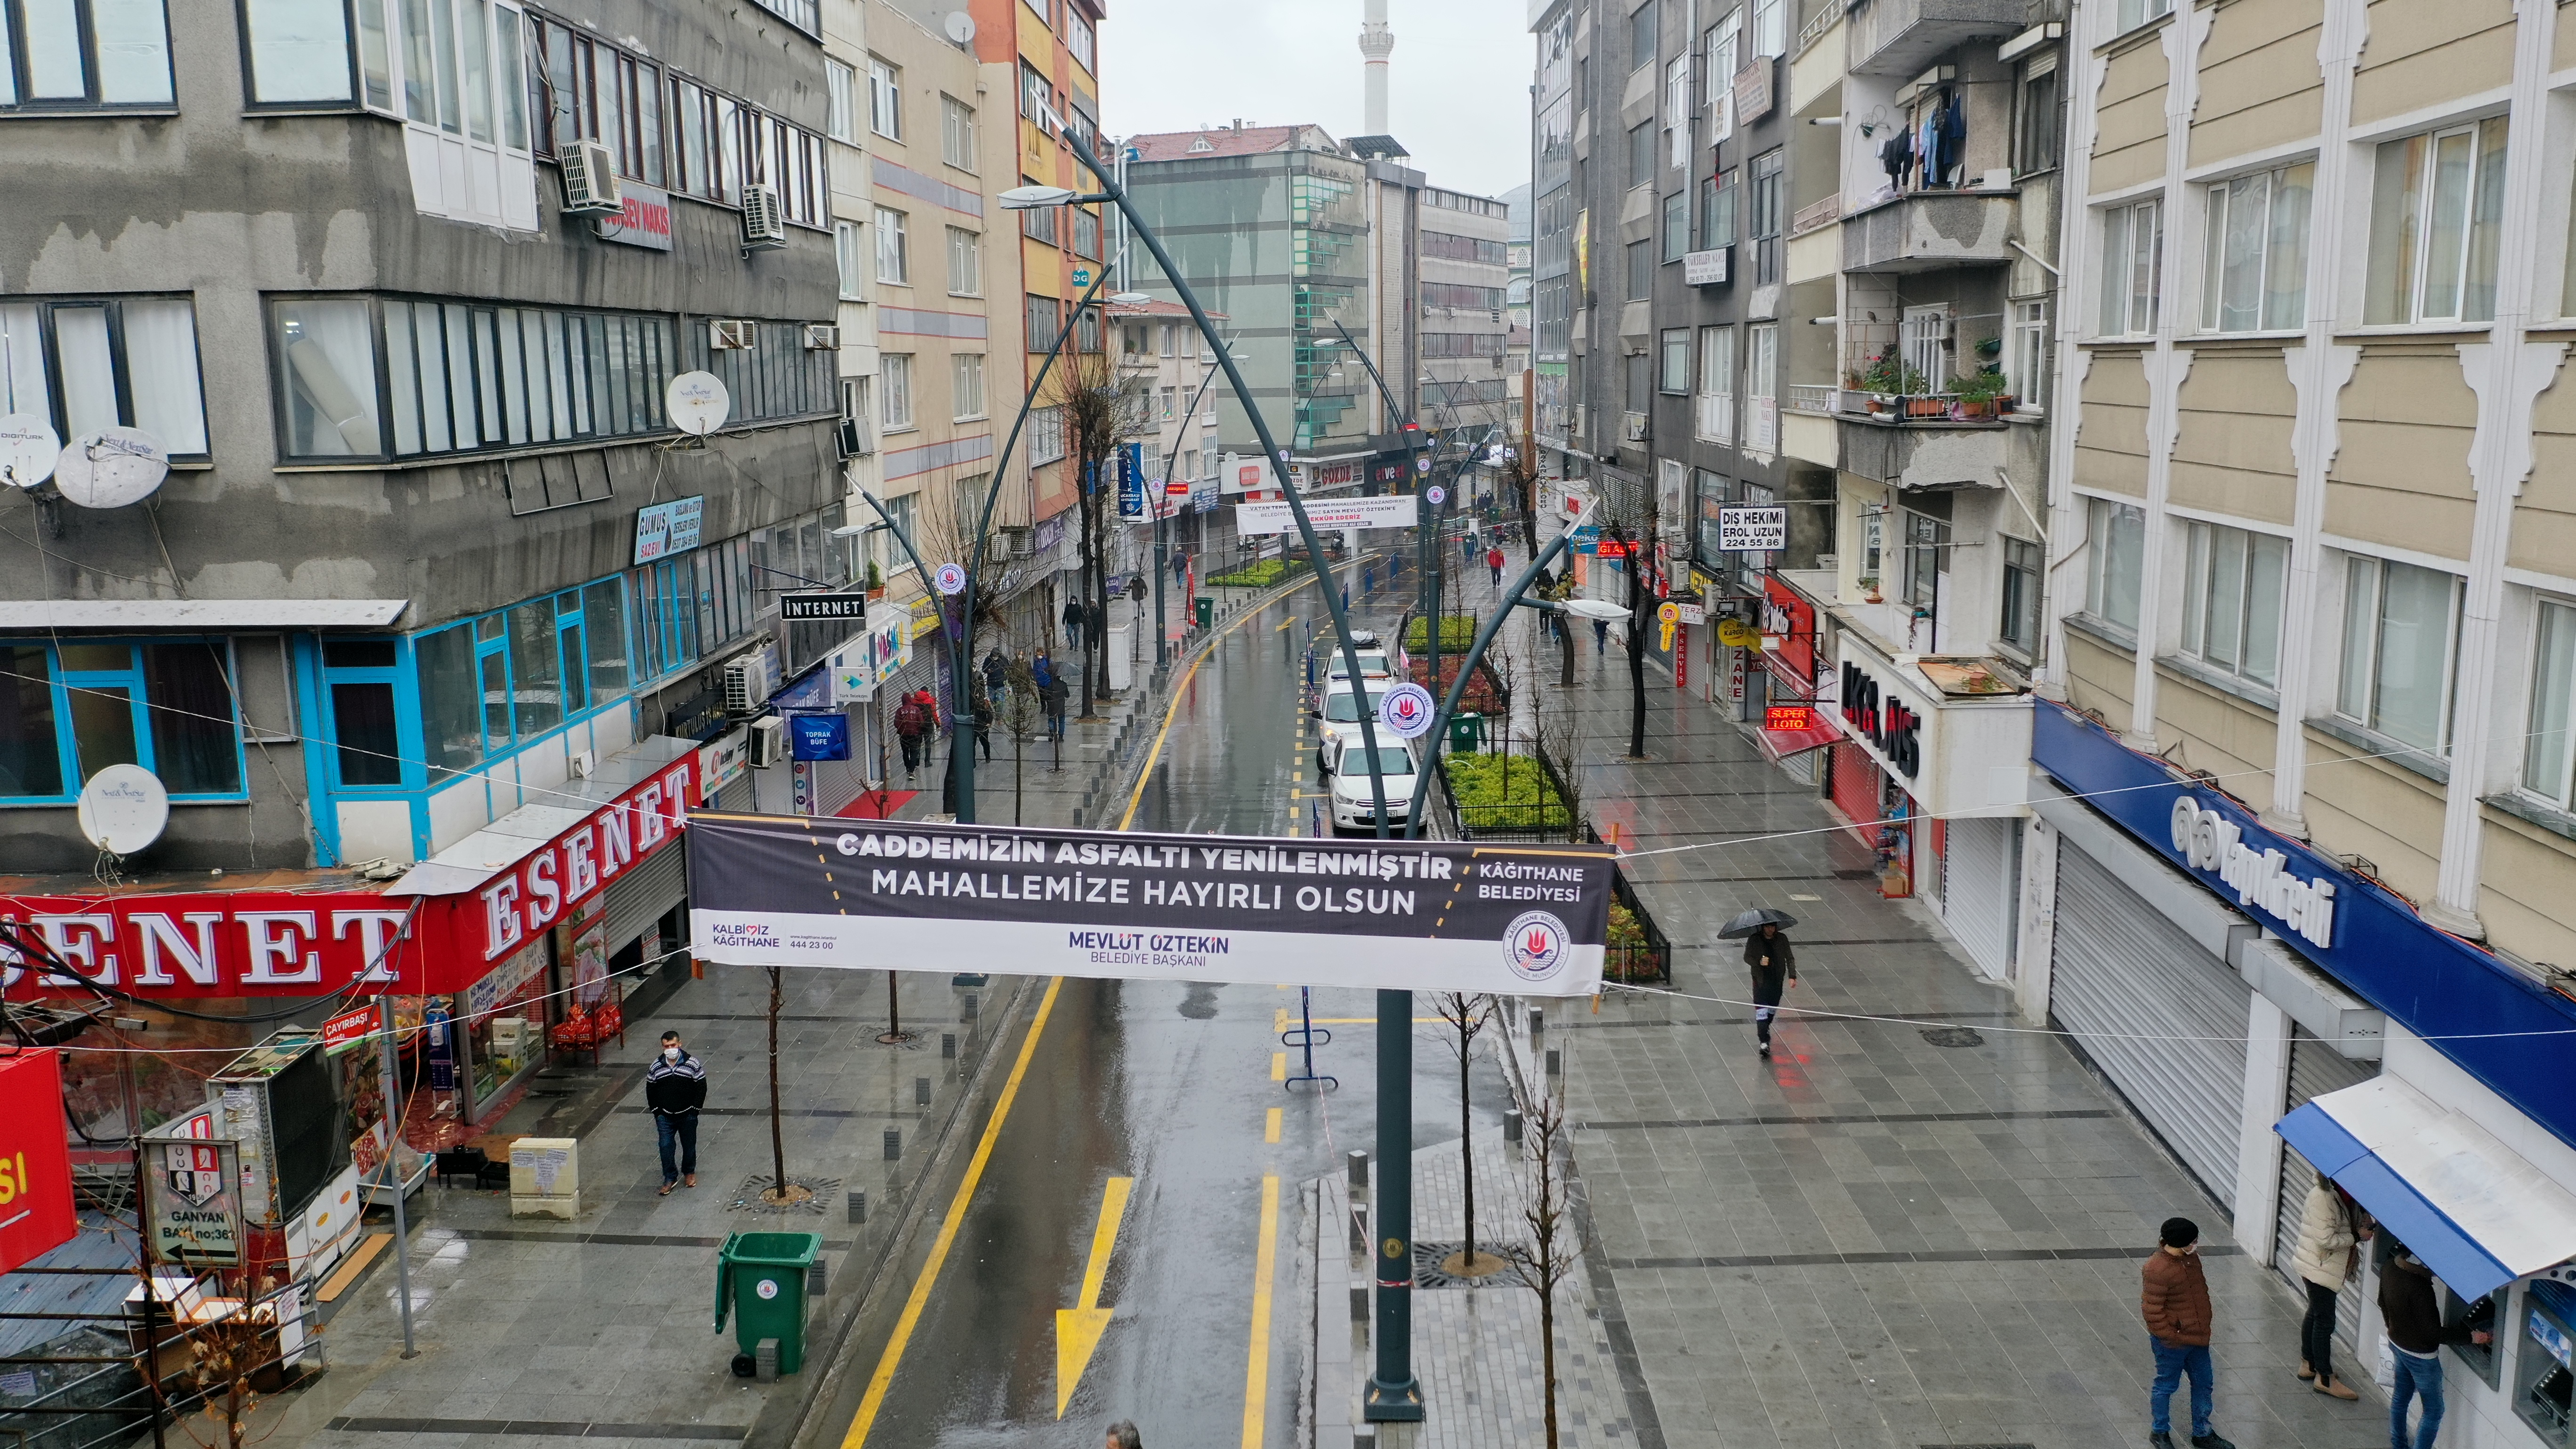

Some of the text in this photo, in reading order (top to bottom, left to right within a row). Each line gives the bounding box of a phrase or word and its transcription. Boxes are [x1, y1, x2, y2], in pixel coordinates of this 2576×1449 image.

[642, 201, 669, 241] NAKIŞ
[1688, 254, 1710, 266] YÜKSELLER
[1321, 464, 1351, 485] GÖZDE
[640, 507, 666, 537] GÜMÜŞ
[1723, 511, 1782, 526] DİŞ HEKİMİ
[1723, 527, 1782, 537] EROL UZUN
[641, 543, 650, 558] SAZ
[786, 600, 860, 615] İNTERNET
[1680, 606, 1701, 614] TERZ
[805, 687, 820, 708] BÜFE
[1408, 687, 1431, 707] BELEDİYESİ
[1771, 710, 1806, 718] SUPER
[1774, 720, 1803, 728] LOTO
[676, 711, 705, 739] KURTULUŞ
[1404, 714, 1431, 735] MUNICIPALITY
[810, 737, 827, 745] BÜFE
[481, 764, 690, 961] ESENET
[837, 833, 1452, 882] CADDEMİZİN ASFALTI YENİLENMİŞTİR
[1480, 861, 1584, 882] KÂĞITHANE
[872, 869, 1415, 915] MAHALLEMİZE HAYIRLI OLSUN
[1479, 884, 1580, 902] BELEDİYESİ
[1540, 915, 1567, 942] BELEDİYESİ
[714, 934, 780, 947] KÂĞITHANE
[1091, 950, 1206, 968] BELEDİYE BAŞKANI
[1532, 951, 1566, 978] MUNICIPALITY
[326, 1013, 368, 1037] ÇAYIRBAŞI
[172, 1211, 225, 1223] GANYAN
